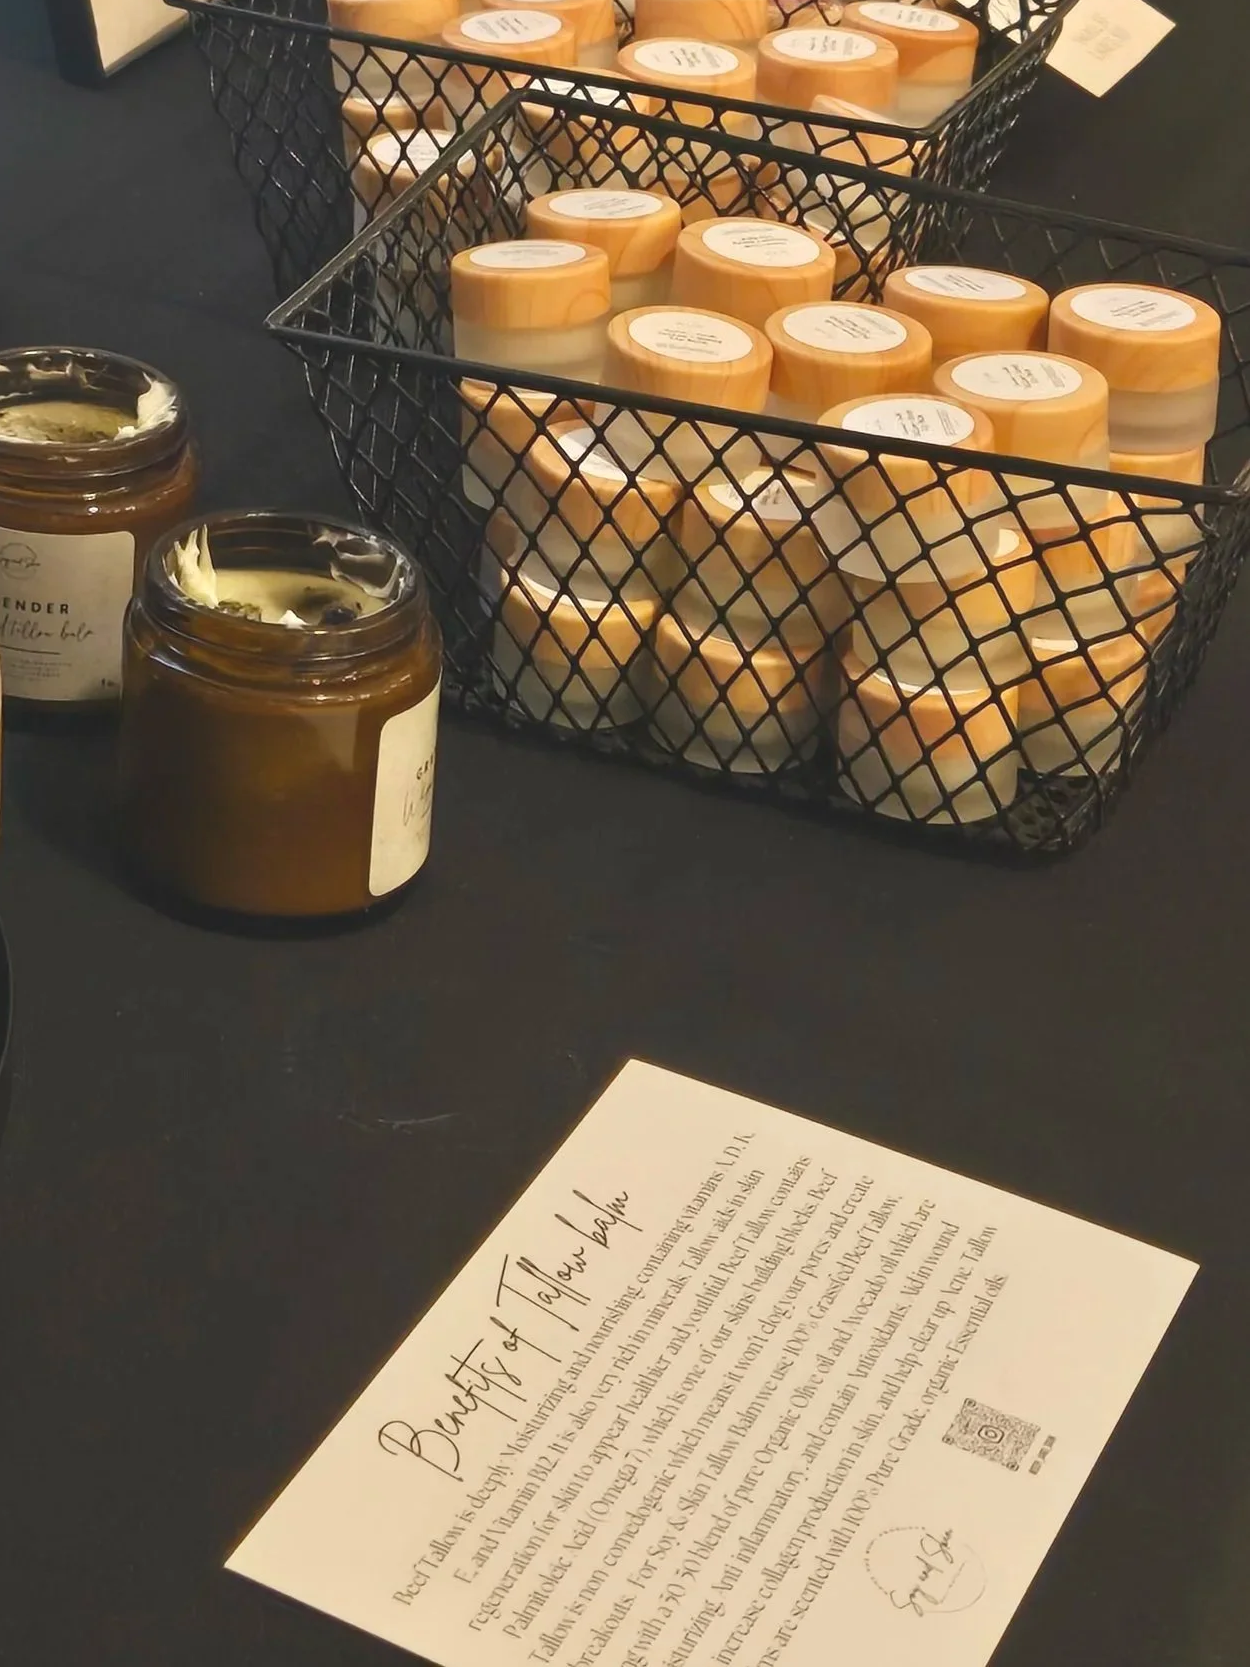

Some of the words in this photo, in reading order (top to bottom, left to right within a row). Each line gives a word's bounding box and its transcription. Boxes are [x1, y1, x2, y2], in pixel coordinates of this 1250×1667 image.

[553, 1189, 643, 1249] balm
[914, 1199, 936, 1221] are
[889, 1221, 922, 1256] which
[923, 1220, 959, 1264] wound
[960, 1226, 997, 1261] Tallow
[880, 1254, 899, 1273] oil
[911, 1265, 933, 1279] in
[495, 1246, 591, 1332] Tallow
[841, 1274, 886, 1324] Avocado
[899, 1276, 925, 1295] Aid
[931, 1300, 955, 1318] up
[489, 1315, 561, 1363] of
[828, 1327, 852, 1356] and
[908, 1318, 938, 1352] clear
[471, 1533, 499, 1567] and
[485, 1482, 540, 1534] Vitamin
[556, 1431, 575, 1442] is
[568, 1400, 596, 1429] also
[590, 1373, 621, 1398] very
[612, 1343, 640, 1370] rich
[627, 1329, 650, 1343] in
[678, 1235, 718, 1270] Tallow
[712, 1206, 736, 1232] aids
[726, 1194, 746, 1207] in
[736, 1169, 764, 1194] skin
[815, 1353, 835, 1373] oil
[885, 1352, 923, 1383] help
[392, 1563, 430, 1605] Beef
[417, 1525, 465, 1568] Tallow
[454, 1509, 475, 1523] is
[466, 1459, 513, 1508] deeply
[499, 1378, 576, 1455] Moisturizing
[559, 1350, 592, 1380] and
[636, 1219, 693, 1283] containing
[680, 1170, 724, 1218] vitamins
[468, 1535, 545, 1631] regeneration
[532, 1510, 559, 1535] for
[551, 1481, 583, 1511] skin
[573, 1464, 593, 1481] to
[588, 1413, 629, 1464] appear
[616, 1354, 671, 1414] healthier
[665, 1325, 691, 1355] and
[717, 1240, 749, 1274] Beef
[736, 1209, 776, 1243] Tallow
[770, 1156, 810, 1206] contains
[502, 1556, 572, 1638] Palmitoleic
[562, 1519, 596, 1549] Acid
[589, 1463, 637, 1521] (Omega
[642, 1404, 679, 1443] which
[666, 1391, 686, 1404] is
[680, 1364, 706, 1391] one
[699, 1343, 716, 1364] of
[711, 1323, 732, 1348] our
[723, 1293, 755, 1325] skins
[742, 1241, 794, 1292] building
[806, 1167, 837, 1200] Beef
[790, 1373, 823, 1408] Olive
[876, 1379, 901, 1410] and
[377, 1338, 527, 1482] Benefits
[528, 1618, 576, 1662] Tallow
[564, 1600, 584, 1615] is
[667, 1428, 705, 1468] which
[696, 1383, 734, 1428] means
[723, 1371, 744, 1382] it
[757, 1304, 791, 1334] clog
[778, 1275, 806, 1309] your
[799, 1240, 831, 1278] pores
[824, 1211, 848, 1239] and
[841, 1175, 874, 1214] create
[626, 1559, 657, 1588] For
[647, 1535, 680, 1559] Soy
[668, 1516, 688, 1531] &
[679, 1483, 710, 1515] Skin
[696, 1440, 739, 1481] Tallow
[727, 1401, 765, 1437] Balm
[755, 1380, 777, 1400] we
[769, 1356, 794, 1380] use
[807, 1261, 855, 1319] Grassfed
[842, 1230, 873, 1264] Beef
[818, 1383, 859, 1435] contain
[754, 1409, 800, 1464] Organic
[800, 1432, 826, 1464] and
[841, 1442, 864, 1457] in
[733, 1465, 764, 1503] pure
[773, 1619, 798, 1647] are
[790, 1555, 835, 1619] scented
[825, 1527, 855, 1557] with
[865, 1452, 899, 1486] Pure
[921, 1354, 958, 1404] organic
[945, 1294, 993, 1354] Essential
[723, 1493, 741, 1516] of
[796, 1457, 855, 1539] production
[687, 1513, 731, 1559] blend
[758, 1537, 805, 1599] collagen
[657, 1606, 673, 1618] a
[890, 1585, 940, 1618] Soy
[633, 1618, 665, 1650] with
[711, 1599, 765, 1662] increase
